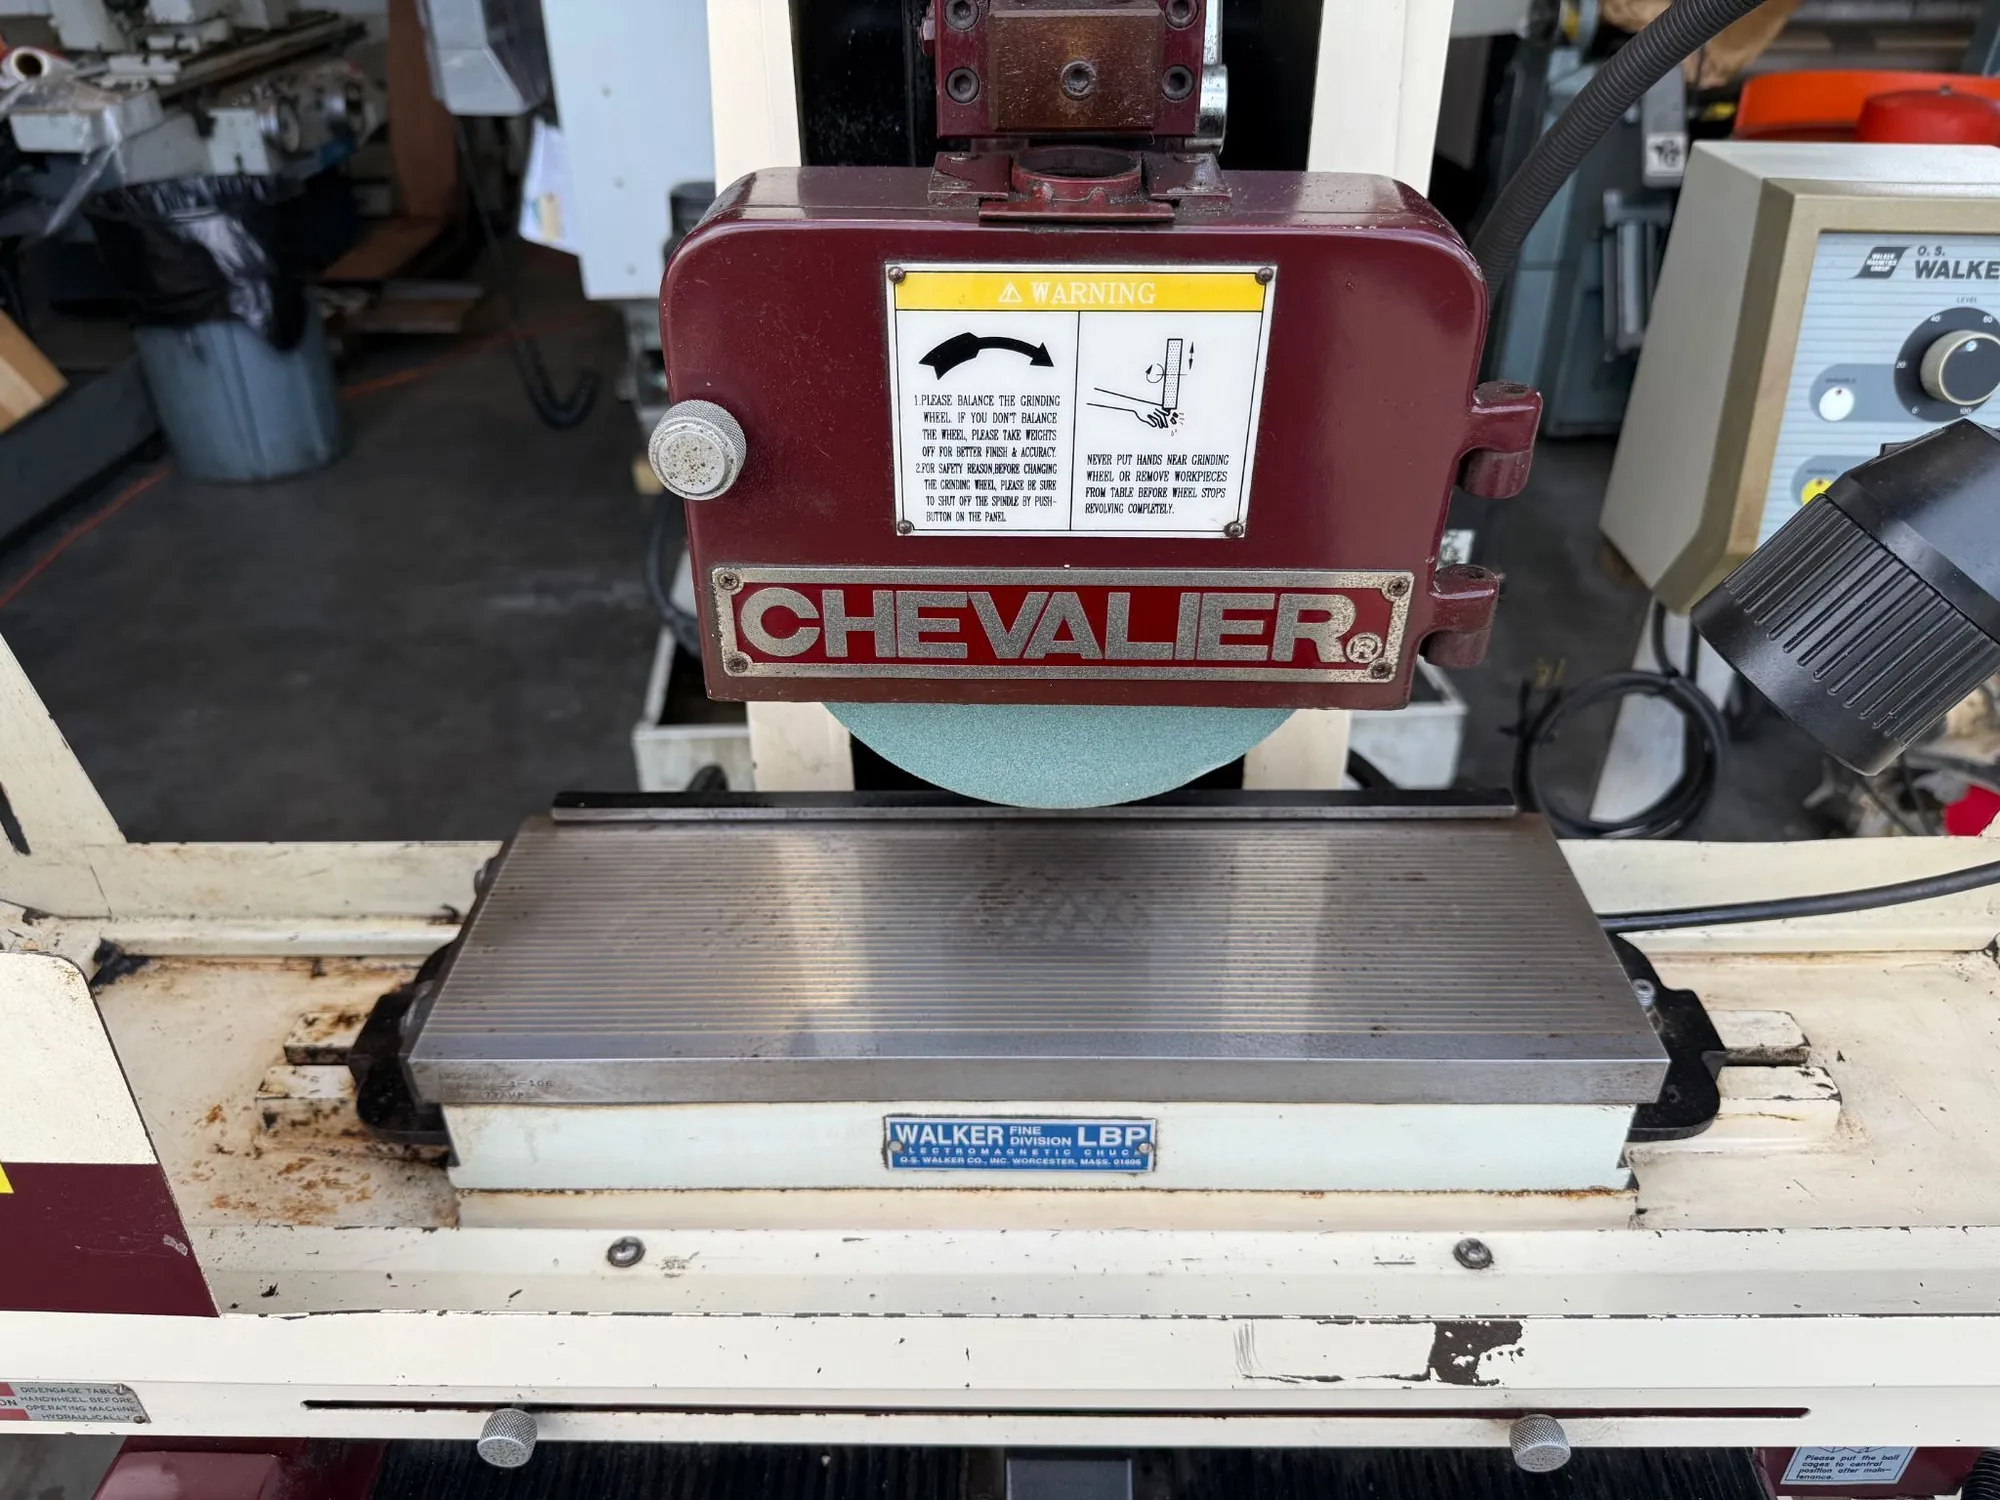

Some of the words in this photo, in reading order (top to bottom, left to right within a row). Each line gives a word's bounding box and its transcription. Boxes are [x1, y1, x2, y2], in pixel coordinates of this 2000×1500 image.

[1917, 246, 1929, 256] O.
[1934, 246, 1945, 256] S.
[1031, 281, 1156, 305] WARNING
[958, 394, 994, 407] BALANCE
[999, 394, 1015, 407] THE
[1020, 394, 1061, 407] GRINDING
[958, 412, 966, 424] IF
[971, 412, 987, 424] YOU
[992, 412, 1016, 424] DON'T
[1021, 412, 1057, 424] BALANCE
[922, 429, 937, 441] THE
[941, 429, 967, 441] WHEEL,
[972, 429, 998, 441] PLEASE
[1003, 429, 1021, 441] TAKE
[1025, 429, 1057, 441] WEIGHTS
[922, 446, 935, 457] OFF
[939, 446, 952, 457] FOR
[957, 446, 982, 457] BETTER
[986, 446, 1007, 457] FINISH
[1087, 454, 1112, 465] NEVER
[1117, 454, 1132, 465] PUT
[1137, 454, 1162, 465] HANDS
[1167, 454, 1187, 465] NEAR
[1192, 454, 1229, 465] GRINDING
[939, 463, 963, 475] SAFETY
[1023, 463, 1057, 475] CHANGING
[1087, 471, 1114, 481] WHEEL
[1119, 471, 1130, 481] OR
[1136, 471, 1169, 481] REMOVE
[1175, 471, 1227, 481] WORKPIECES
[924, 480, 937, 491] THE
[941, 480, 970, 491] GRINDING
[975, 480, 996, 491] WHEEL,
[1001, 480, 1024, 491] PLEASE
[1028, 480, 1036, 491] BE
[1040, 480, 1056, 491] SURE
[1085, 487, 1105, 498] FROM
[1111, 487, 1134, 498] TABLE
[1138, 487, 1167, 498] BEFORE
[1172, 487, 1197, 498] WHEEL
[1201, 487, 1226, 498] STOPS
[926, 496, 934, 506] TO
[938, 496, 955, 506] SHUT
[959, 496, 972, 506] OFF
[976, 496, 988, 506] THE
[992, 496, 1019, 506] SPINDLE
[1023, 496, 1031, 506] BY
[1085, 504, 1123, 514] REVOLVING
[1128, 504, 1174, 514] COMPLETELY.
[926, 512, 951, 522] BUTTON
[956, 512, 964, 522] ON
[969, 512, 981, 522] THE
[740, 587, 1358, 663] CHEVALIER
[895, 1124, 1004, 1145] WALKER
[1009, 1126, 1041, 1135] FINE
[1010, 1137, 1072, 1146] DIVISION
[1077, 1127, 1147, 1146] LBP
[905, 1147, 1072, 1155] LECTROMAGNETIC
[25, 1404, 86, 1412] OPERATING
